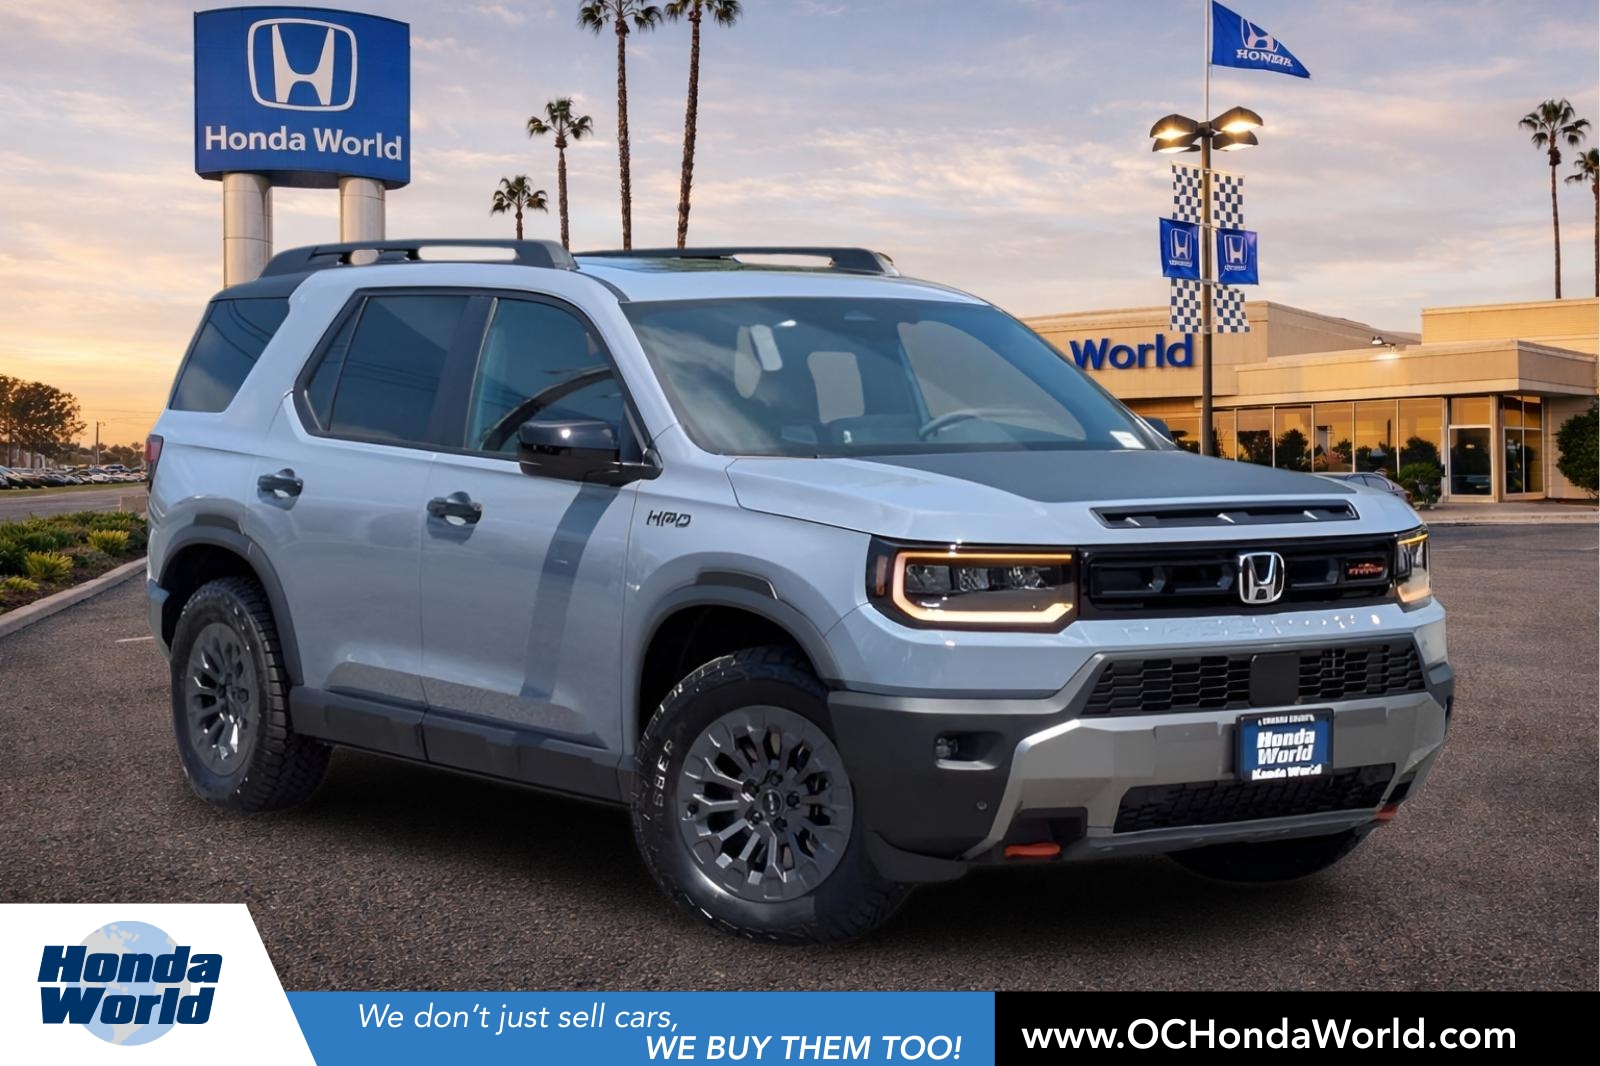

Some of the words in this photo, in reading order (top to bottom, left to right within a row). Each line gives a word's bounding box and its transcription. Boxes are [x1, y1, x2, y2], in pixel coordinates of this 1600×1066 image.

[205, 125, 306, 151] Honda
[313, 127, 402, 160] World
[1069, 332, 1193, 370] World
[646, 510, 691, 528] HPD
[1256, 728, 1316, 749] Honda
[1257, 744, 1314, 765] World
